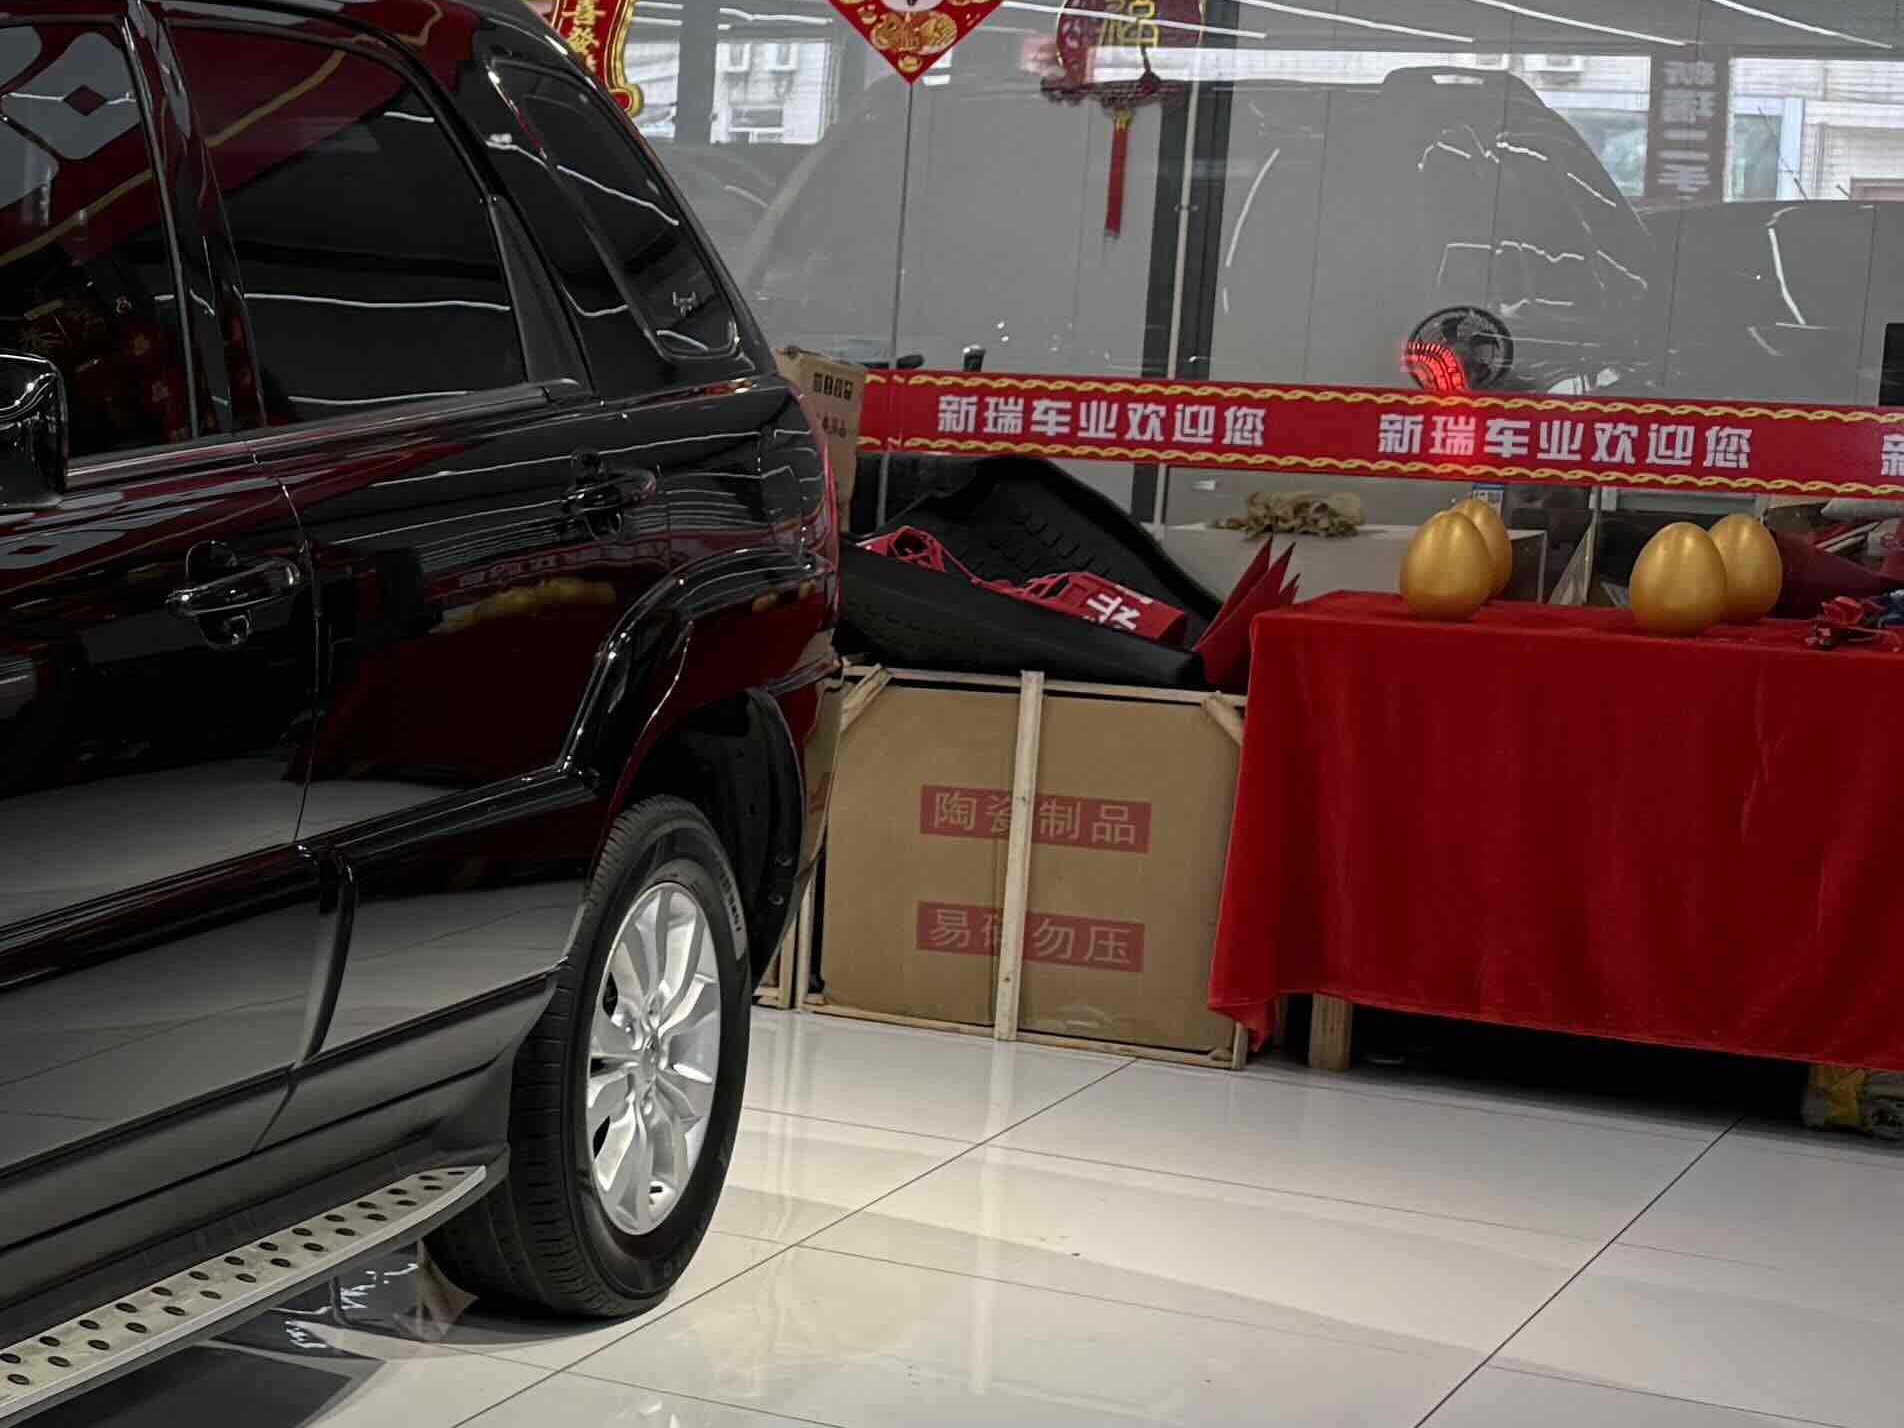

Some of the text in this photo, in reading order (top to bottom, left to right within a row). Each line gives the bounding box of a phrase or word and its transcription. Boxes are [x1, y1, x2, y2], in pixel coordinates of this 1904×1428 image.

[936, 394, 1267, 447] 新瑞车业欢迎您
[1377, 413, 1753, 469] 新瑞车业欢迎您
